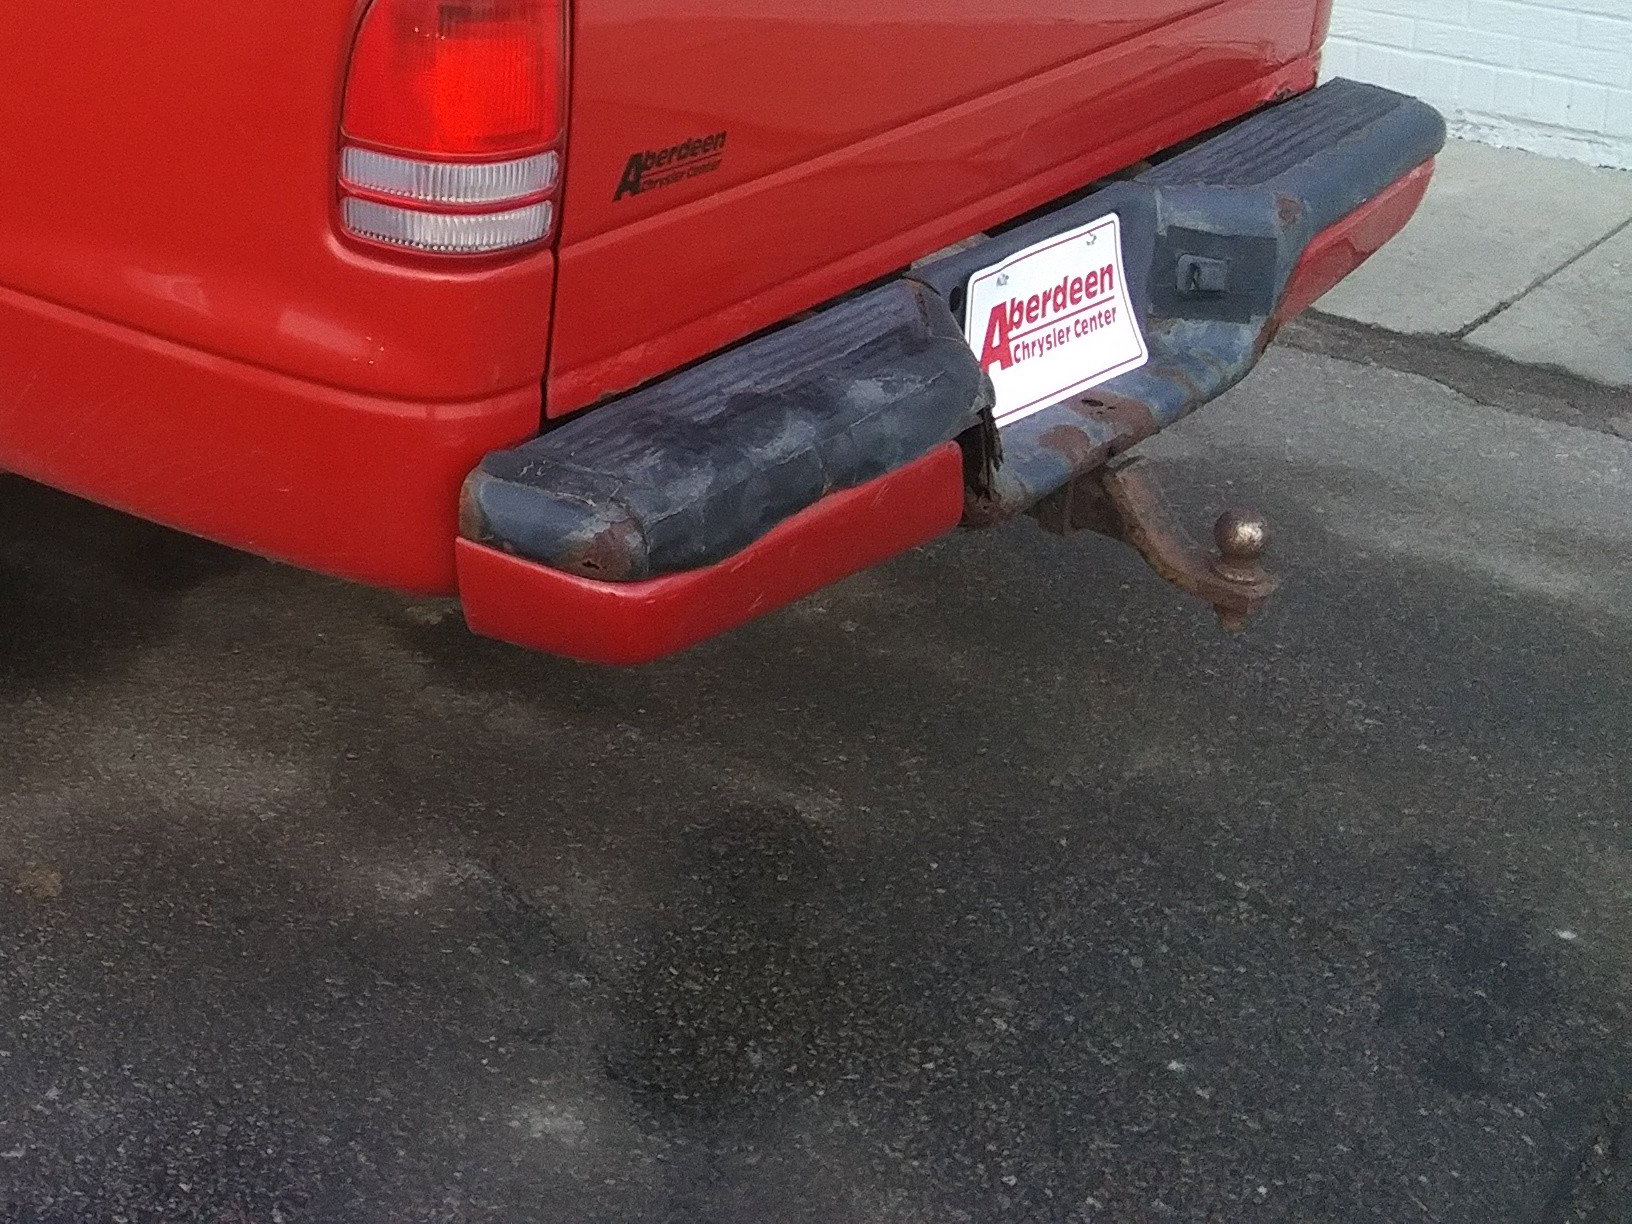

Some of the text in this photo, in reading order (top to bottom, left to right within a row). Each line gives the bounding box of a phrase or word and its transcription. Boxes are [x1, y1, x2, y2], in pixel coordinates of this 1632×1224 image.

[612, 130, 728, 202] Aberdeen
[978, 263, 1115, 373] Aberdeen
[1013, 306, 1117, 364] Chrysler Center
